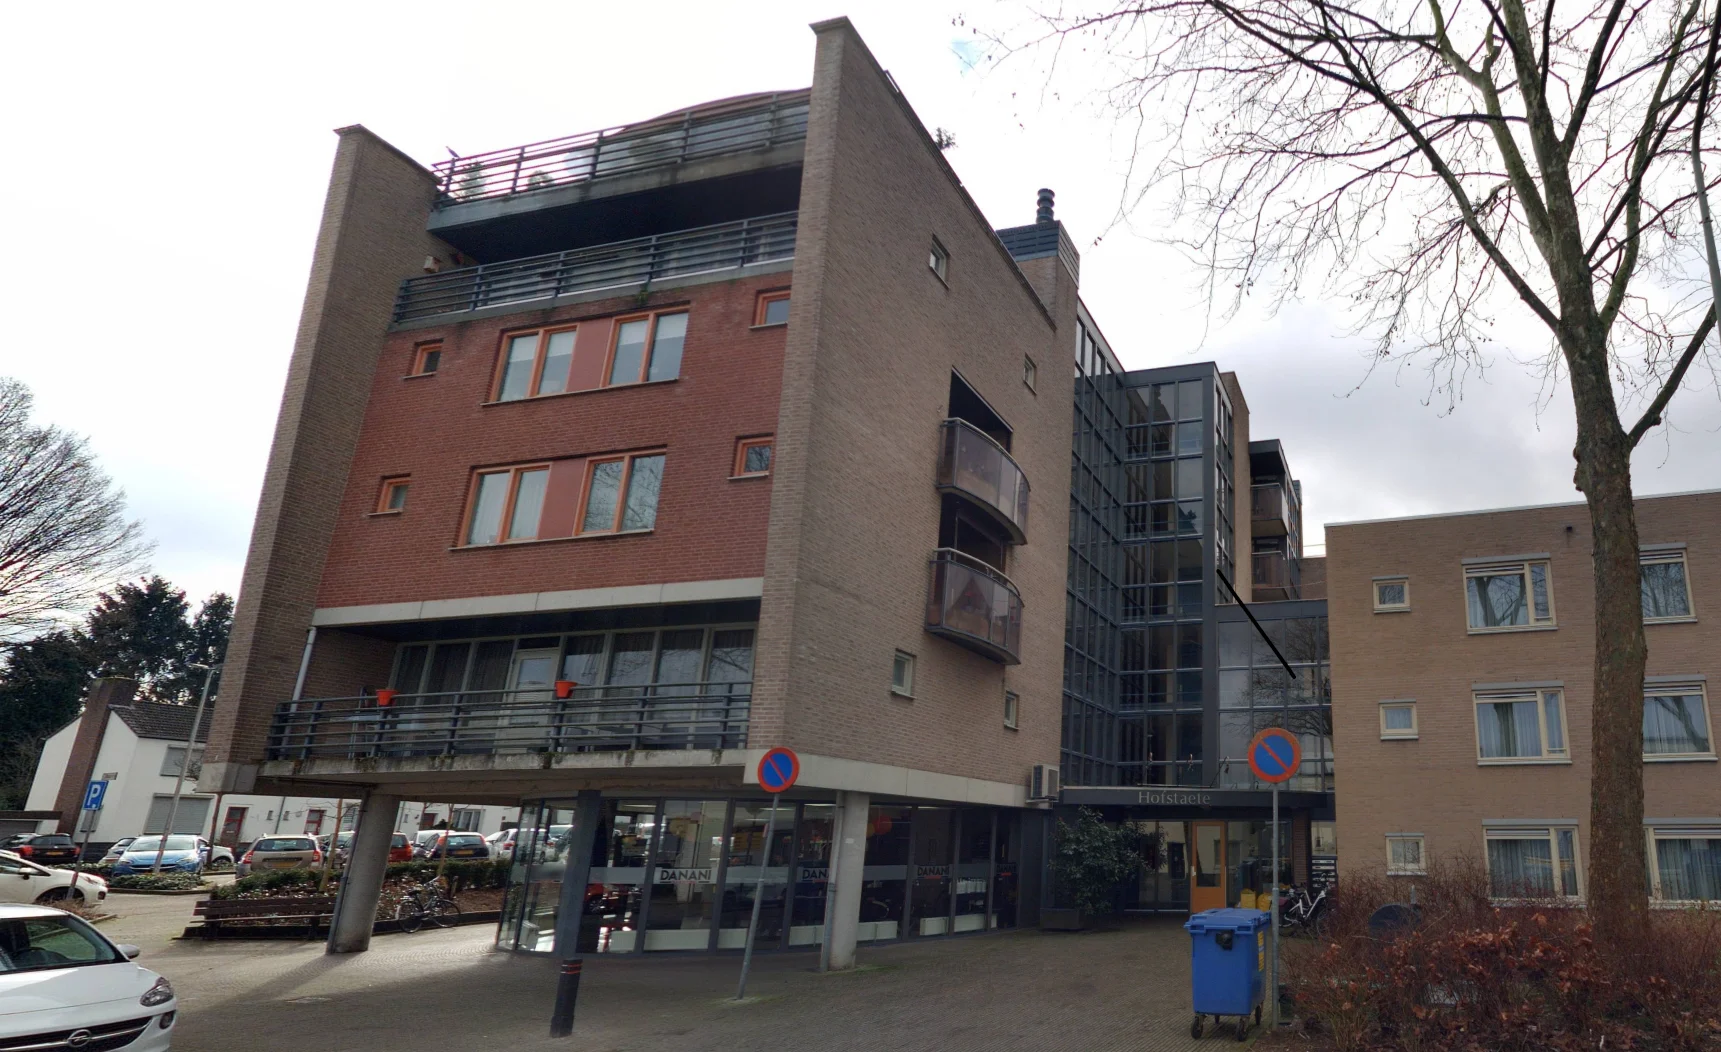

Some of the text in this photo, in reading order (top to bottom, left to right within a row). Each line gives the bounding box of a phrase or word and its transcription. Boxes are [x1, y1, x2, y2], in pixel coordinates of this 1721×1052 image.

[87, 784, 101, 806] P
[660, 870, 711, 881] DANANI
[802, 869, 830, 880] DAN
